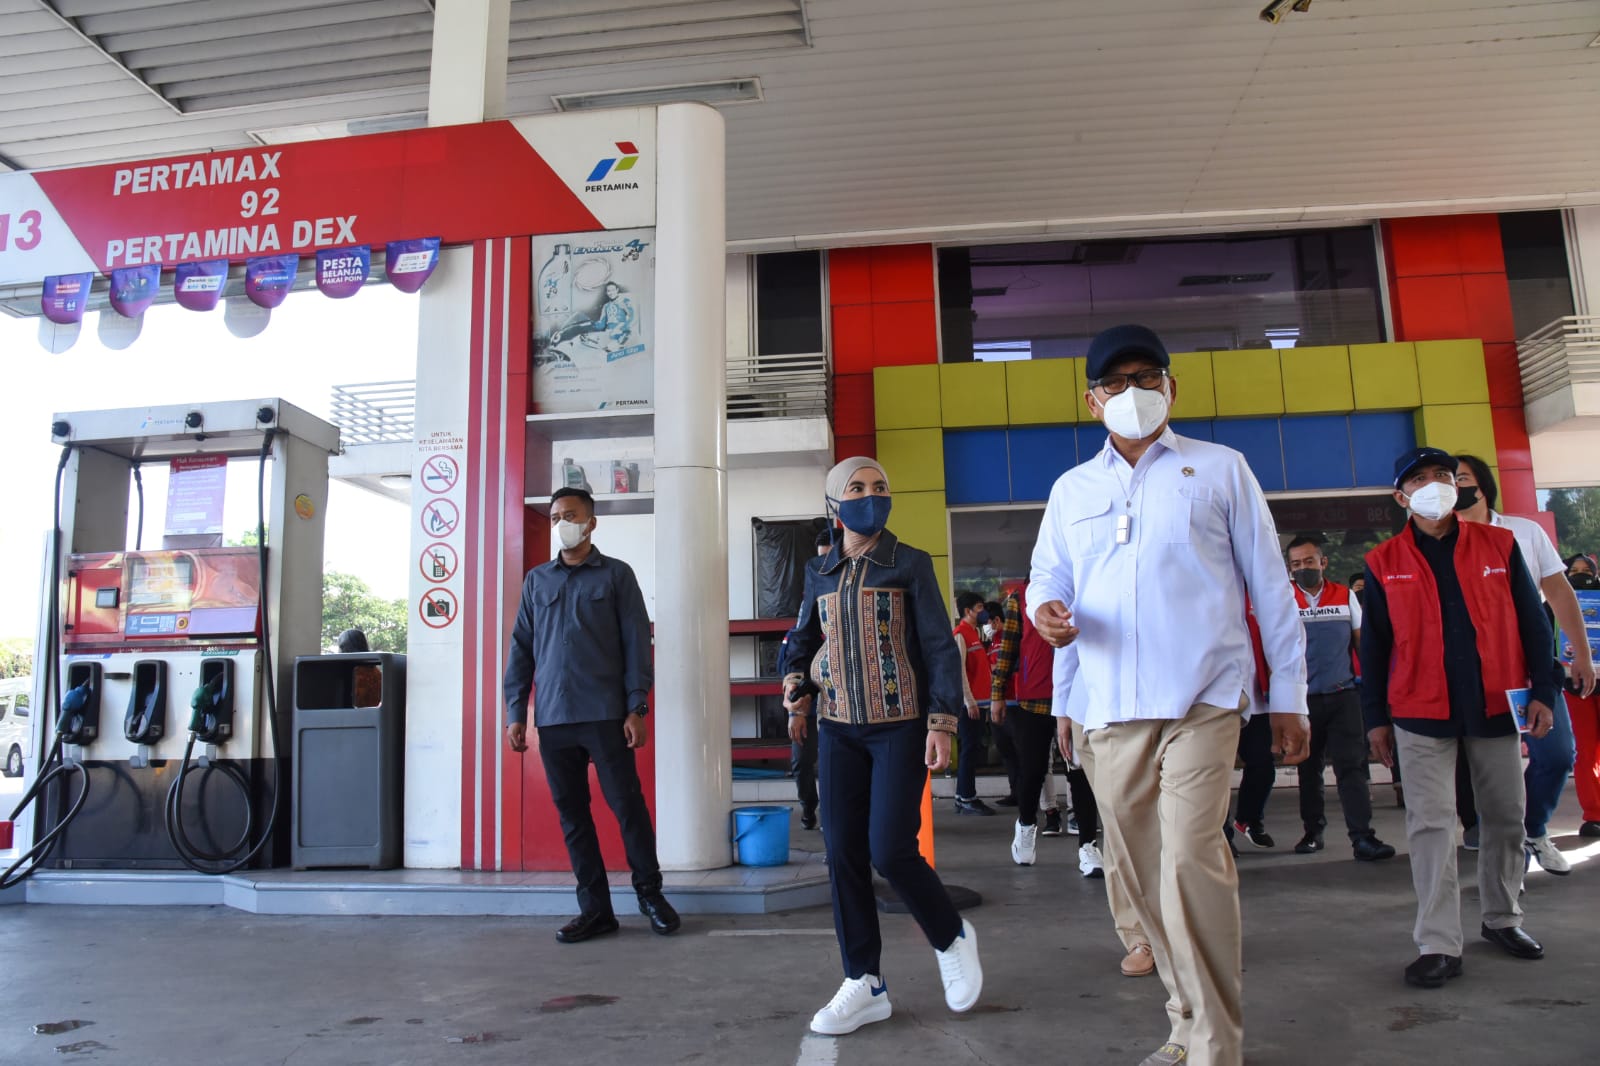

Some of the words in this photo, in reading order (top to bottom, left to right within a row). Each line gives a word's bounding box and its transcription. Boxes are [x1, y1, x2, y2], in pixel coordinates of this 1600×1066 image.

[113, 152, 282, 196] PERTAMAX
[585, 182, 638, 192] PERTAMINA
[240, 188, 280, 218] 92
[106, 223, 281, 267] PERTAMINA
[292, 215, 357, 249] DEX
[323, 257, 363, 270] PESTA
[322, 268, 362, 279] BELANJA
[344, 275, 363, 283] POIN
